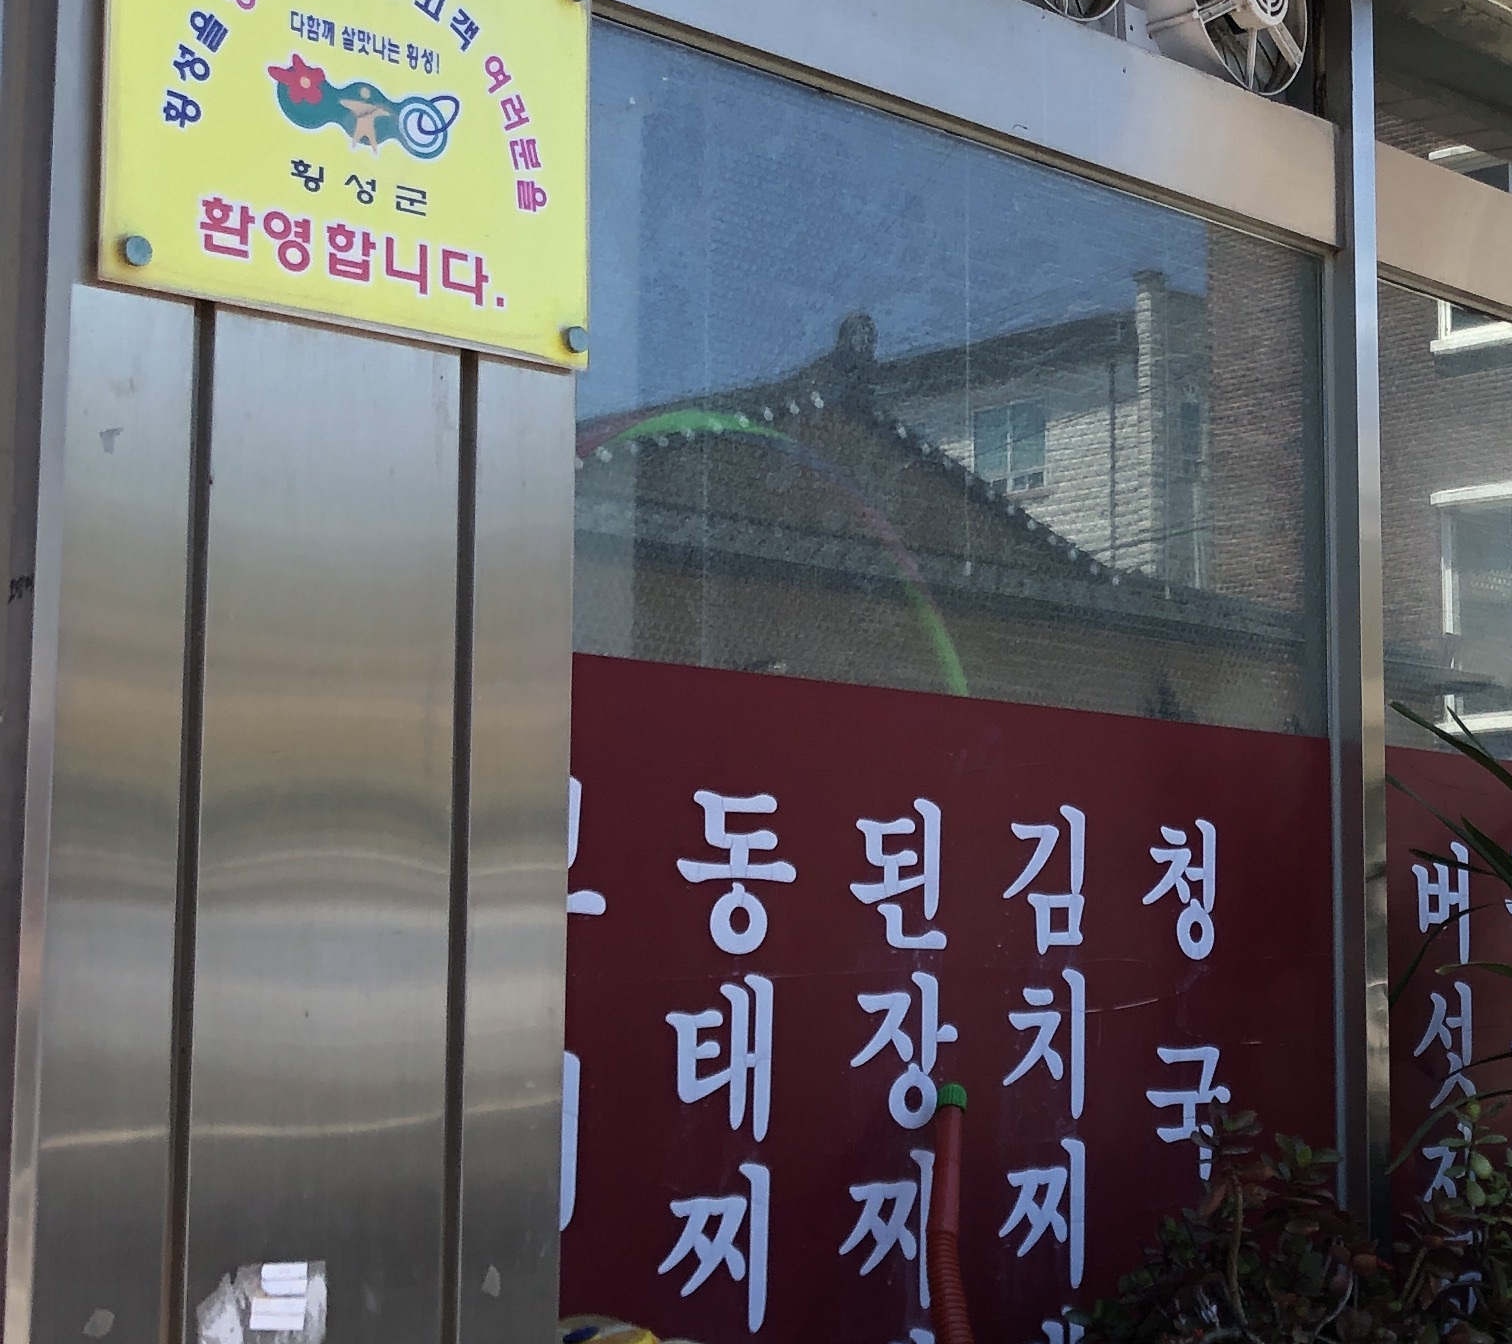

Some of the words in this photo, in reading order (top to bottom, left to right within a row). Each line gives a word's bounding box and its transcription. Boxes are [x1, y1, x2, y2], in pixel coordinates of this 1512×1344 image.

[290, 10, 335, 47] 다함께
[342, 26, 400, 65] 살맛나는
[163, 10, 229, 129] 횡성을
[485, 56, 548, 212] 여러분을
[199, 197, 506, 308] 환영합니다.
